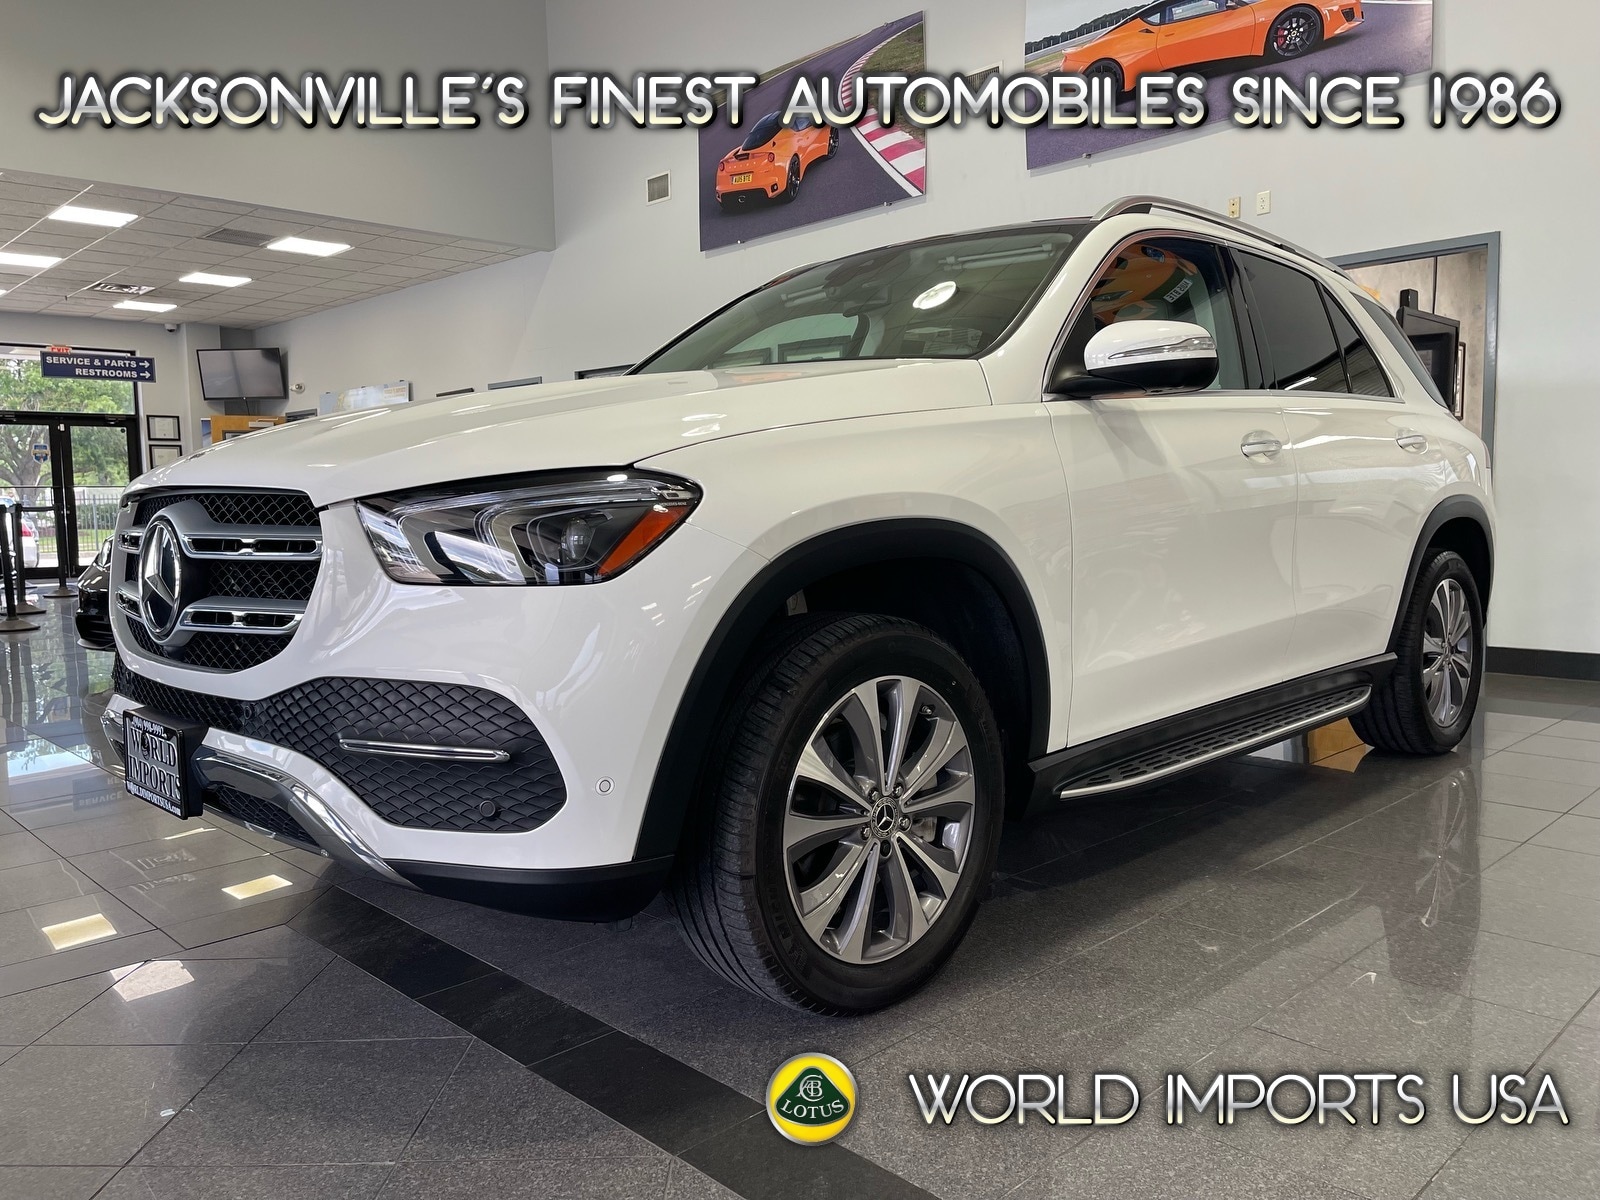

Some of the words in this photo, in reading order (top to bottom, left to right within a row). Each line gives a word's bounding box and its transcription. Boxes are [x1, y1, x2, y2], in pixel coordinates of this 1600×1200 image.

[46, 356, 91, 366] SERVICE
[104, 360, 137, 368] PARTS
[75, 368, 138, 378] RESTROOMS
[130, 726, 178, 767] WORLD
[128, 755, 180, 800] IMPORTS
